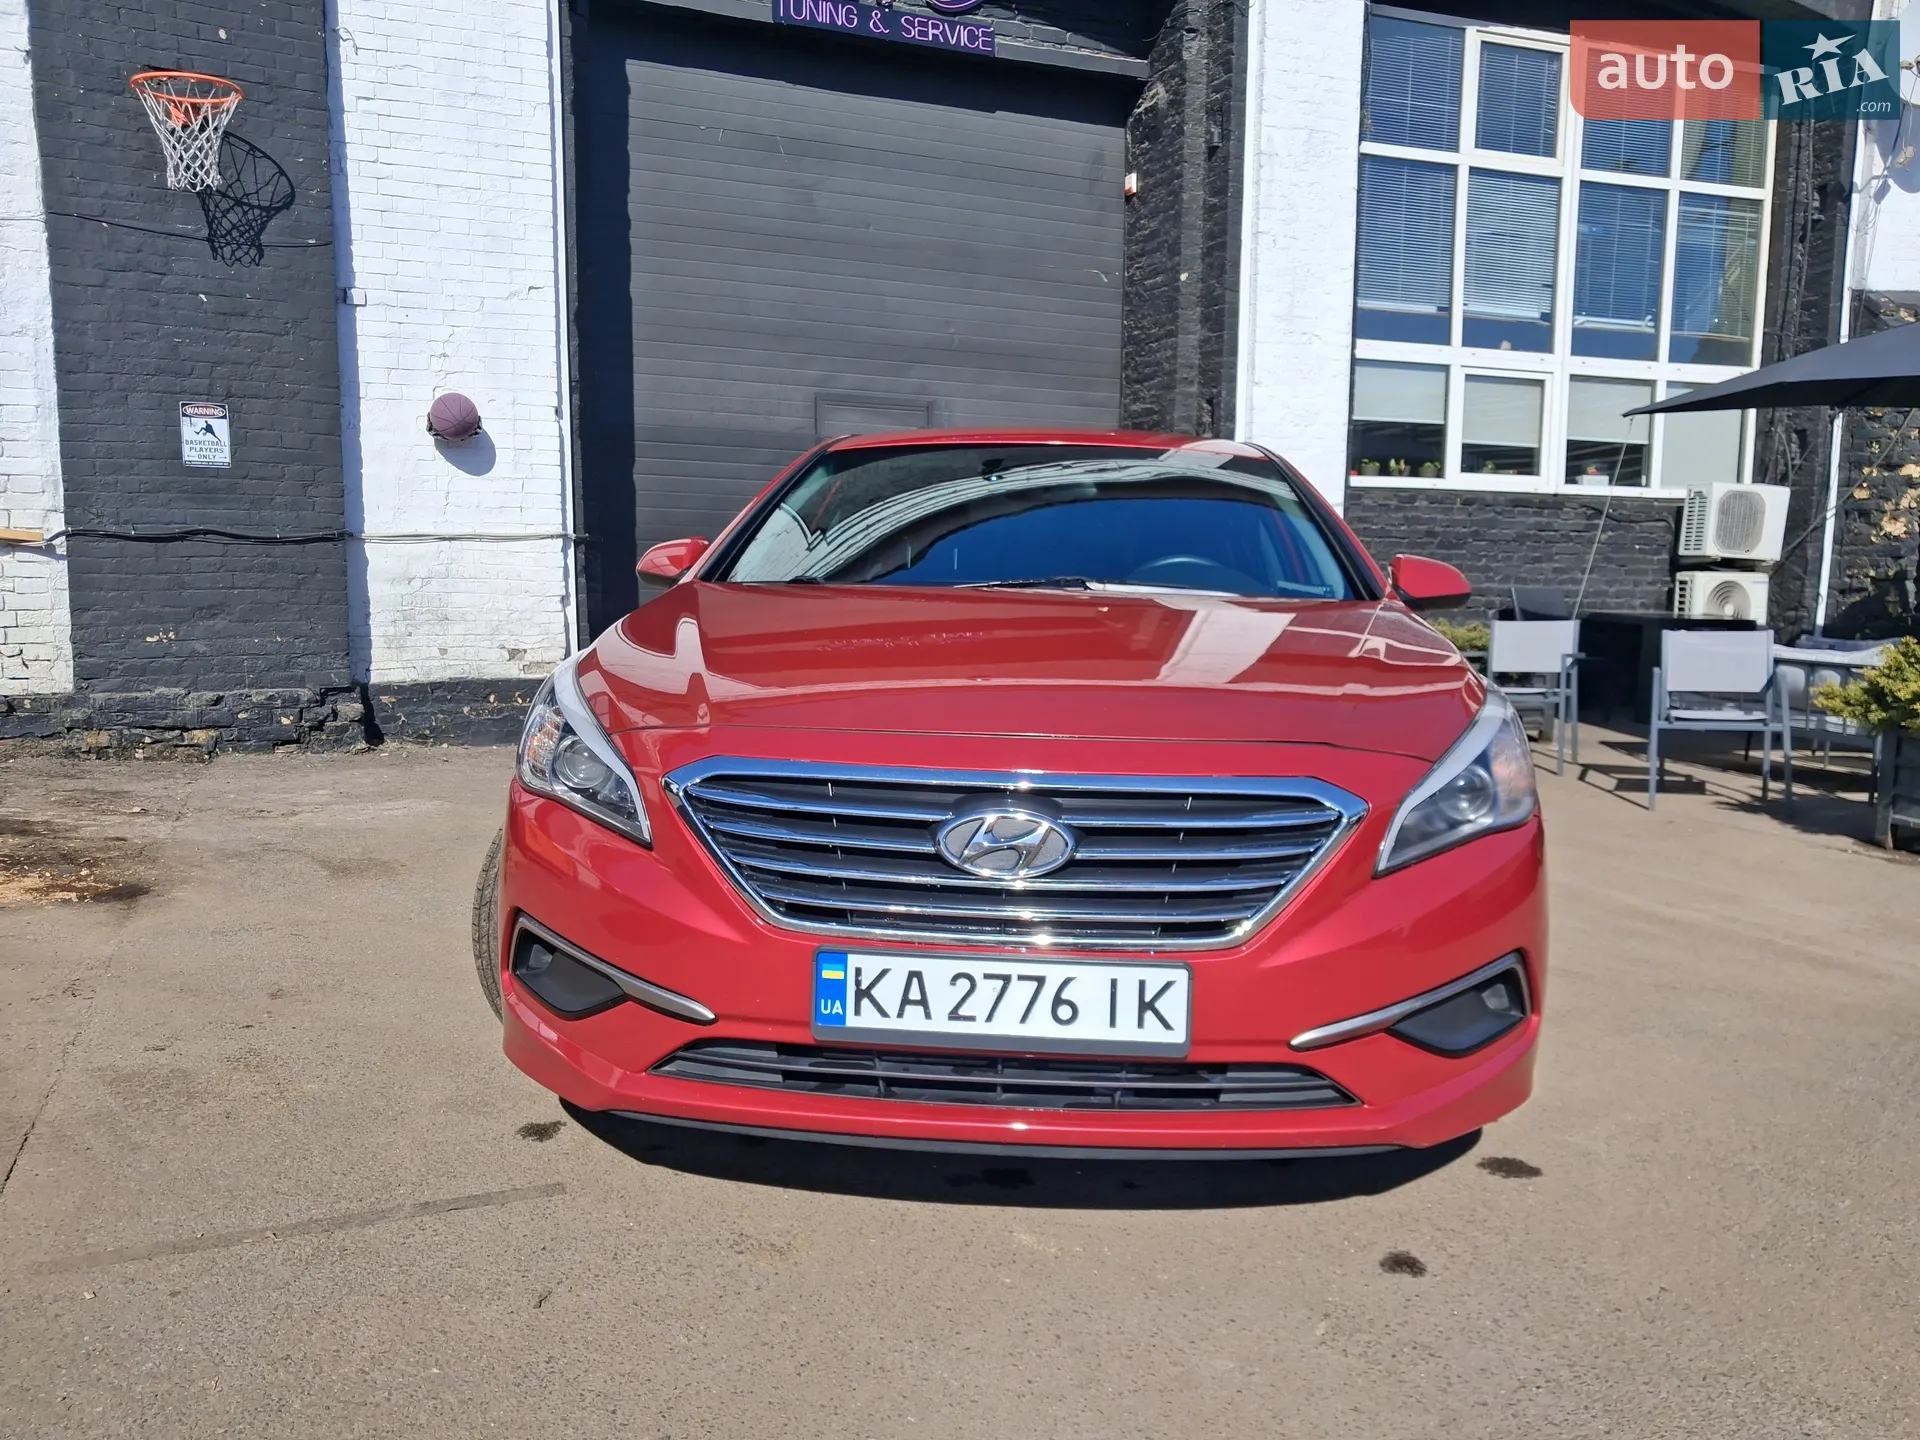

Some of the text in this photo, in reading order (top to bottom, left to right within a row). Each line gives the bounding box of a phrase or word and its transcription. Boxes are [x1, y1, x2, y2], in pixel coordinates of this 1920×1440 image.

[869, 9, 890, 34] &
[900, 15, 993, 51] SERVICE
[186, 407, 224, 416] WARNING
[820, 998, 844, 1016] UA
[853, 966, 1177, 1032] KA 2776 IK
